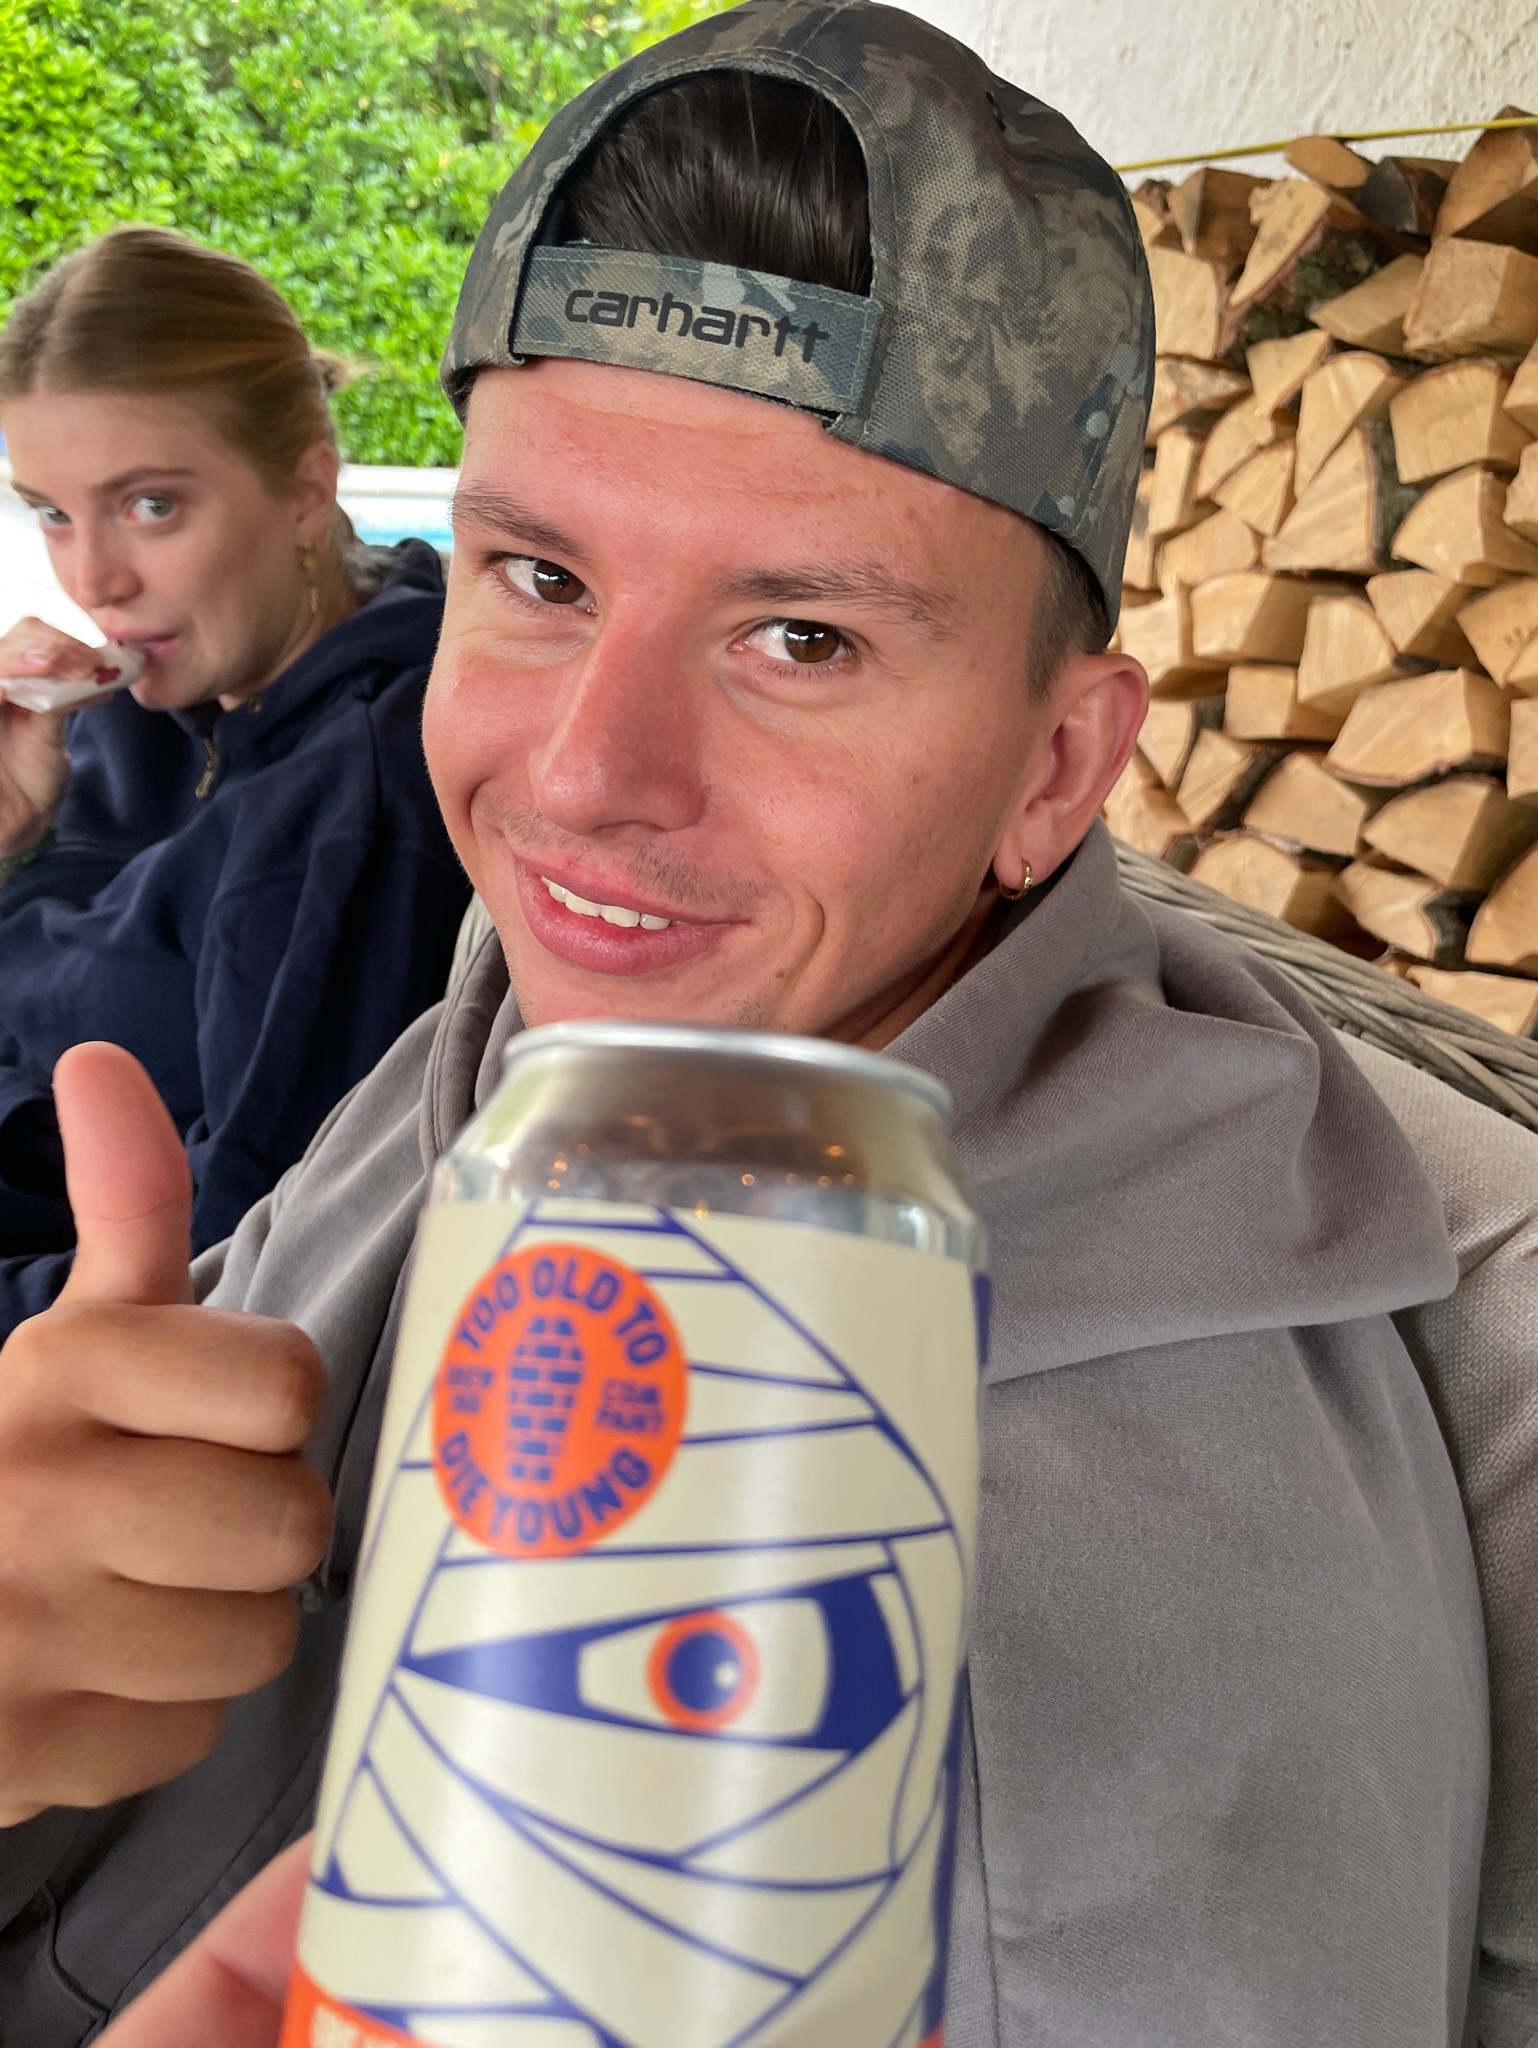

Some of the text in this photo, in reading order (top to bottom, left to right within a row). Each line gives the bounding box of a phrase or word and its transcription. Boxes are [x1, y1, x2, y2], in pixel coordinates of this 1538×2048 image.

[564, 289, 830, 363] carhartt
[458, 1258, 668, 1366] TOO OLD TO
[439, 1430, 651, 1544] DIE YOUNG
